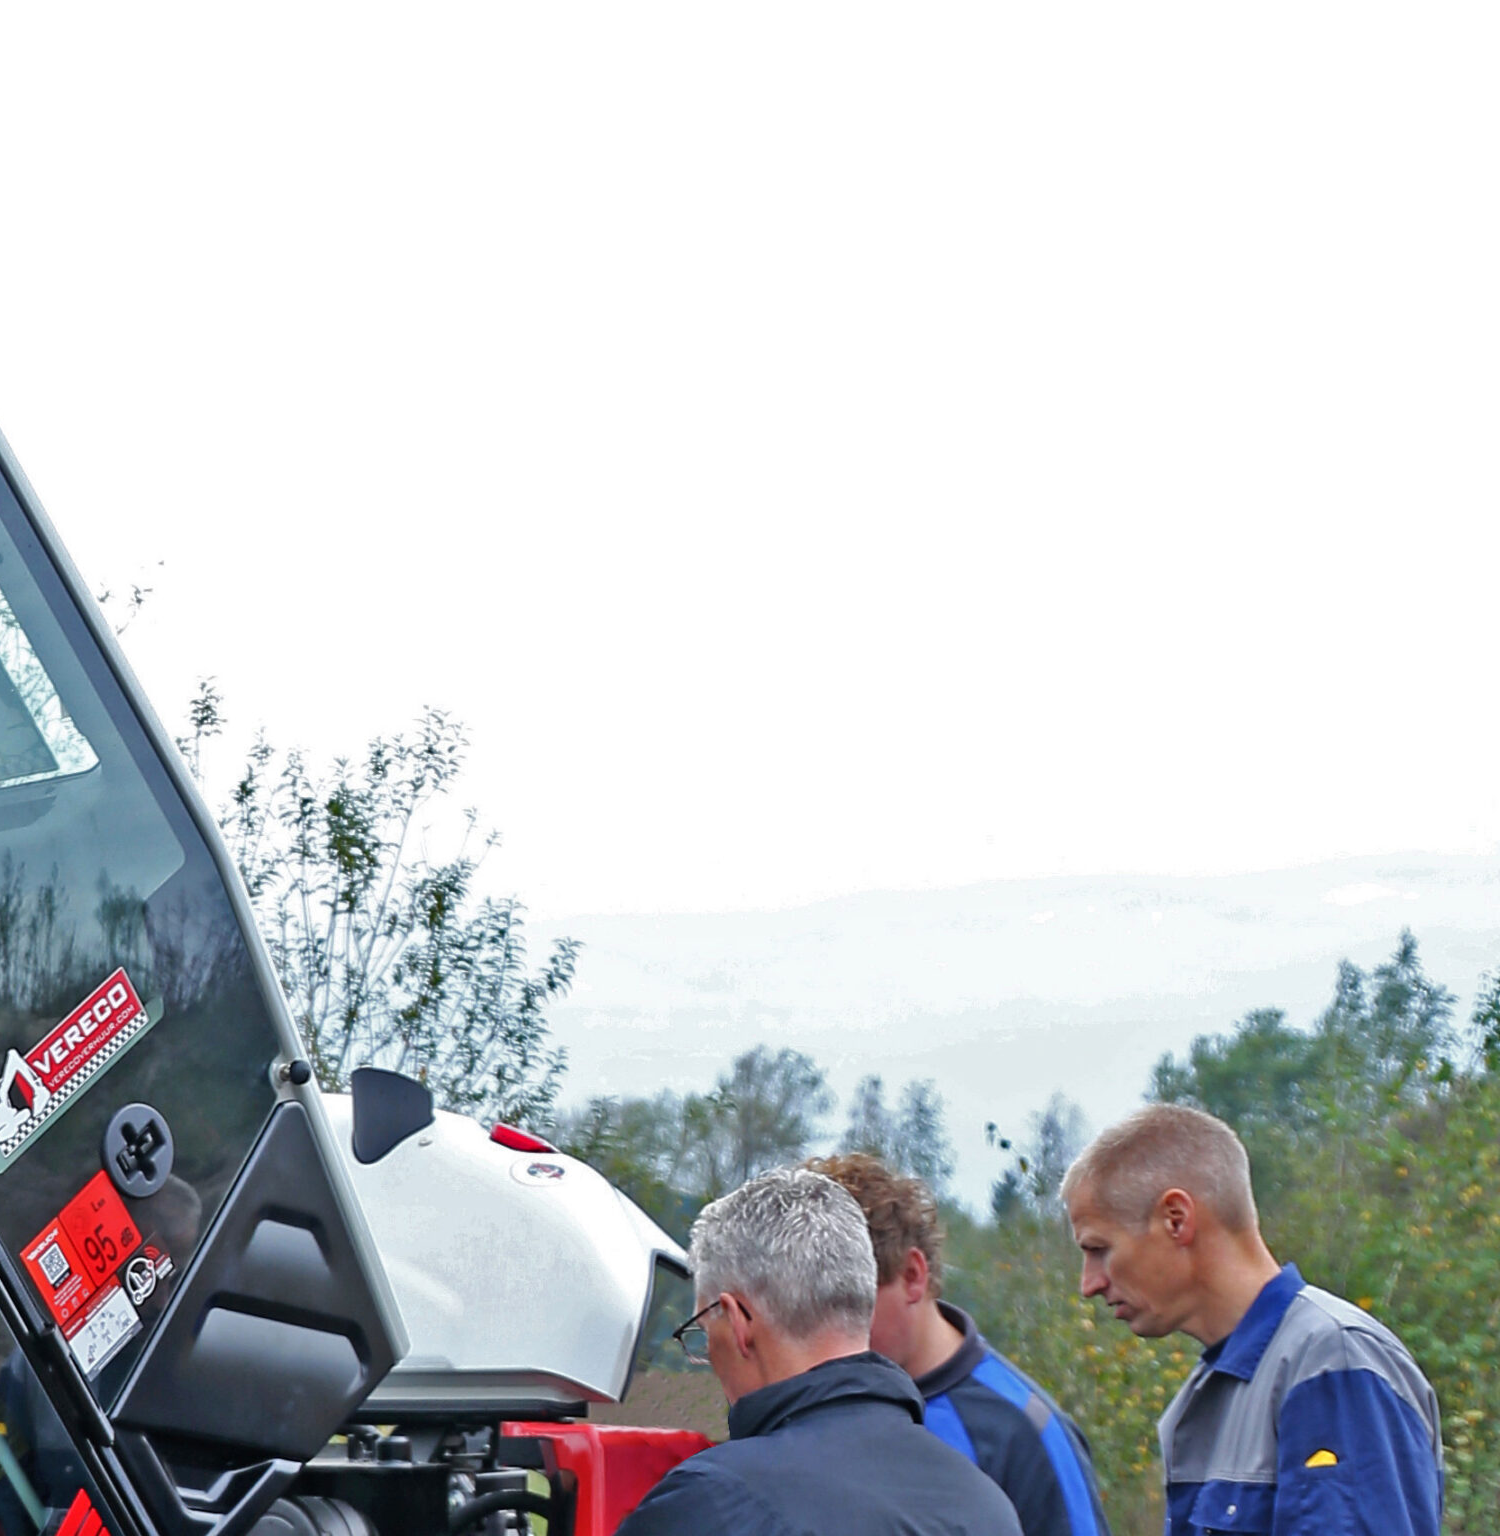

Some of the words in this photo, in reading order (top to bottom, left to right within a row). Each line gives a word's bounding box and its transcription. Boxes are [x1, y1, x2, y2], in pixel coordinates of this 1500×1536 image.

[32, 982, 128, 1074] VERECO
[48, 1004, 135, 1087] VERECOVERHUUR.COM
[83, 1223, 118, 1274] 95
[120, 1226, 134, 1248] dB
